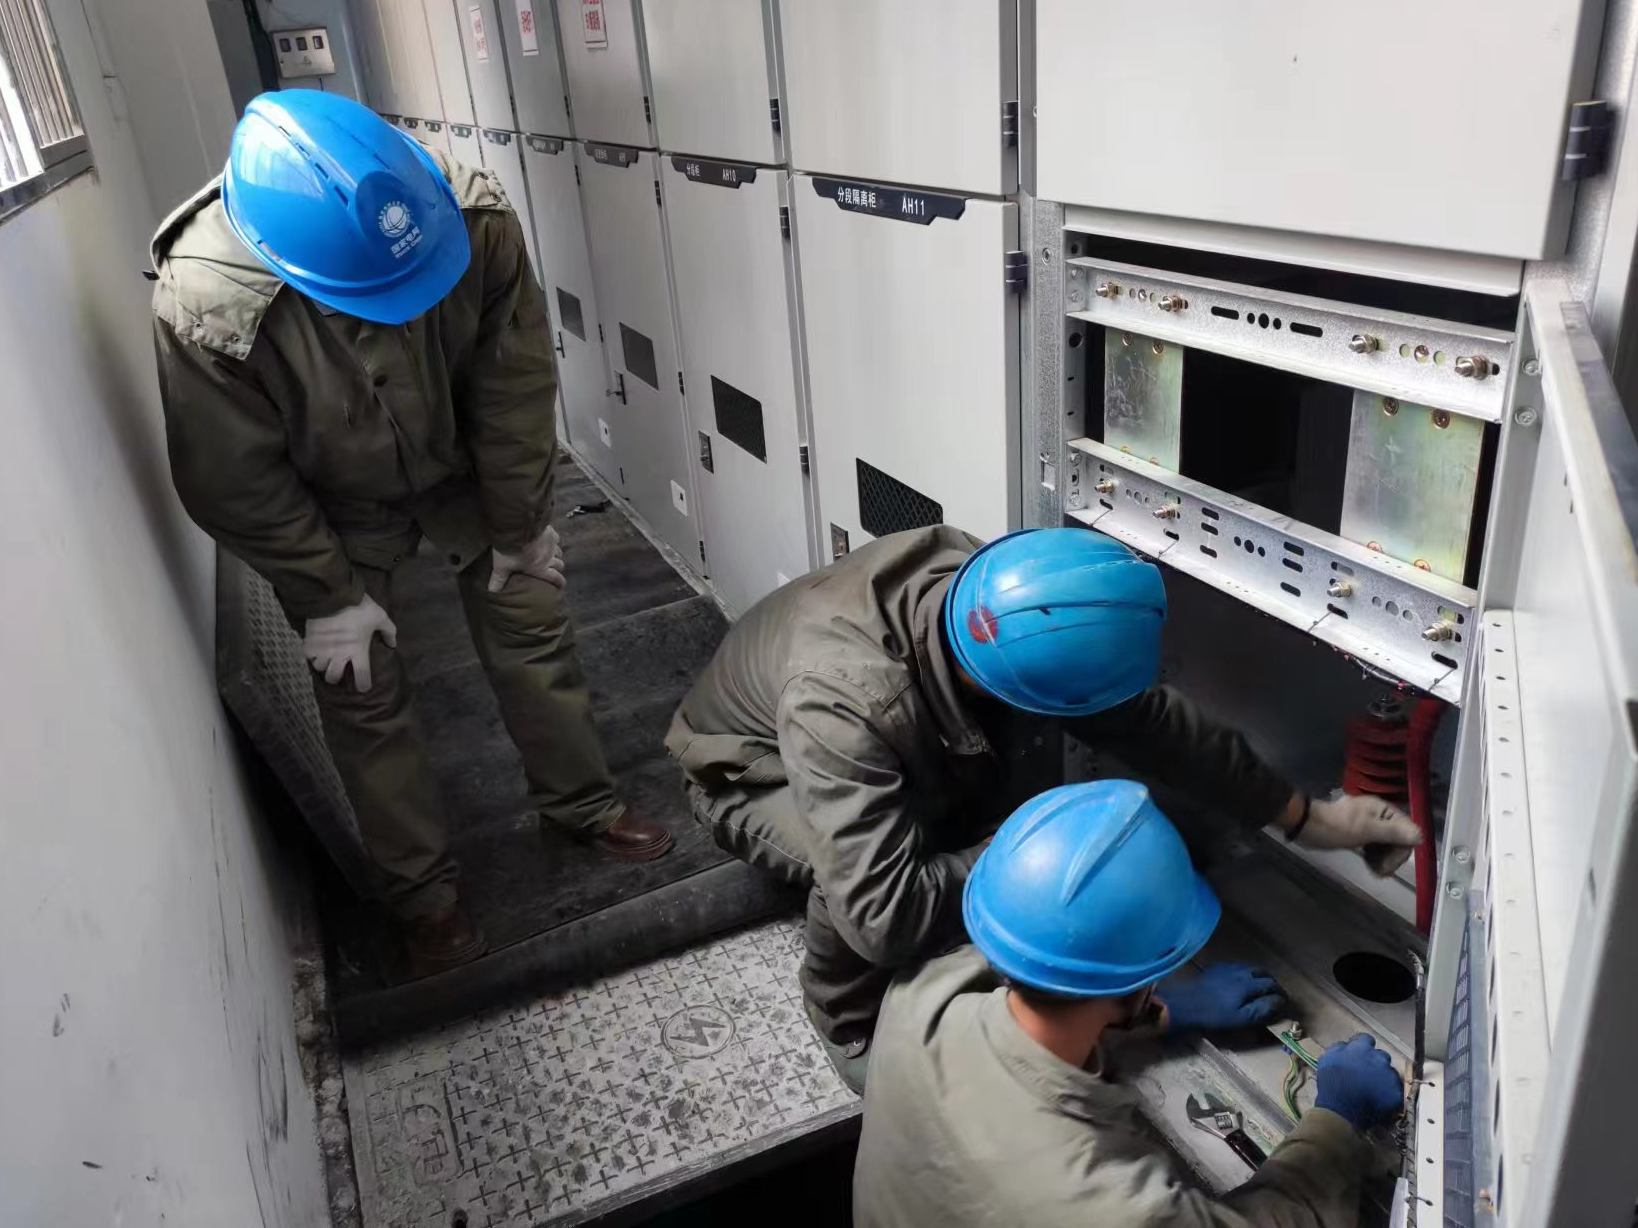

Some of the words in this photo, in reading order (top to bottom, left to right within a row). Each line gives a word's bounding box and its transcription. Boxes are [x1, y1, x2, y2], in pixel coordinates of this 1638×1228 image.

[722, 168, 737, 182] AH10
[837, 186, 877, 208] 分段隔离柜
[901, 197, 926, 216] AH11
